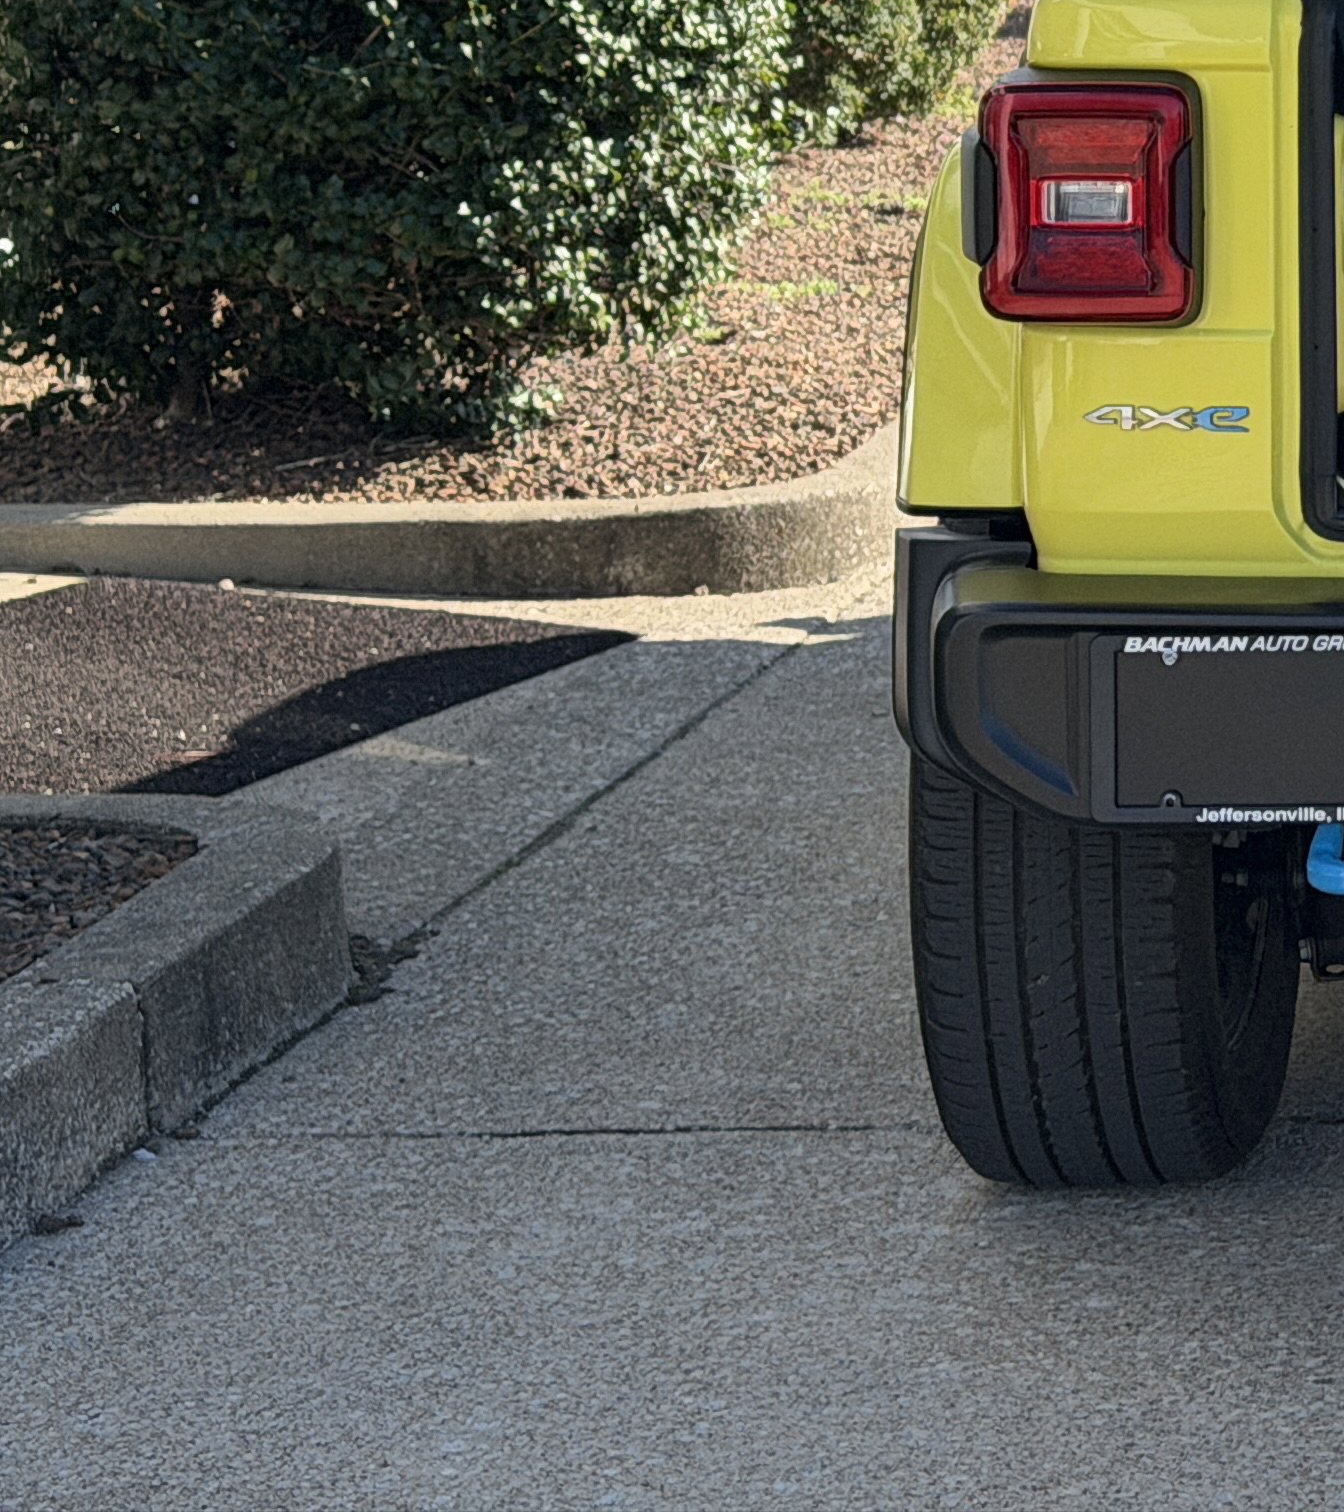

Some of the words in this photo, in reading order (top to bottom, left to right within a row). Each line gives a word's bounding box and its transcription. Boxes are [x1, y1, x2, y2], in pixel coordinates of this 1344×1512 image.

[1124, 636, 1249, 653] BACHMAN
[1250, 635, 1309, 652] AUTO
[1196, 807, 1332, 823] Jeffersonville,
